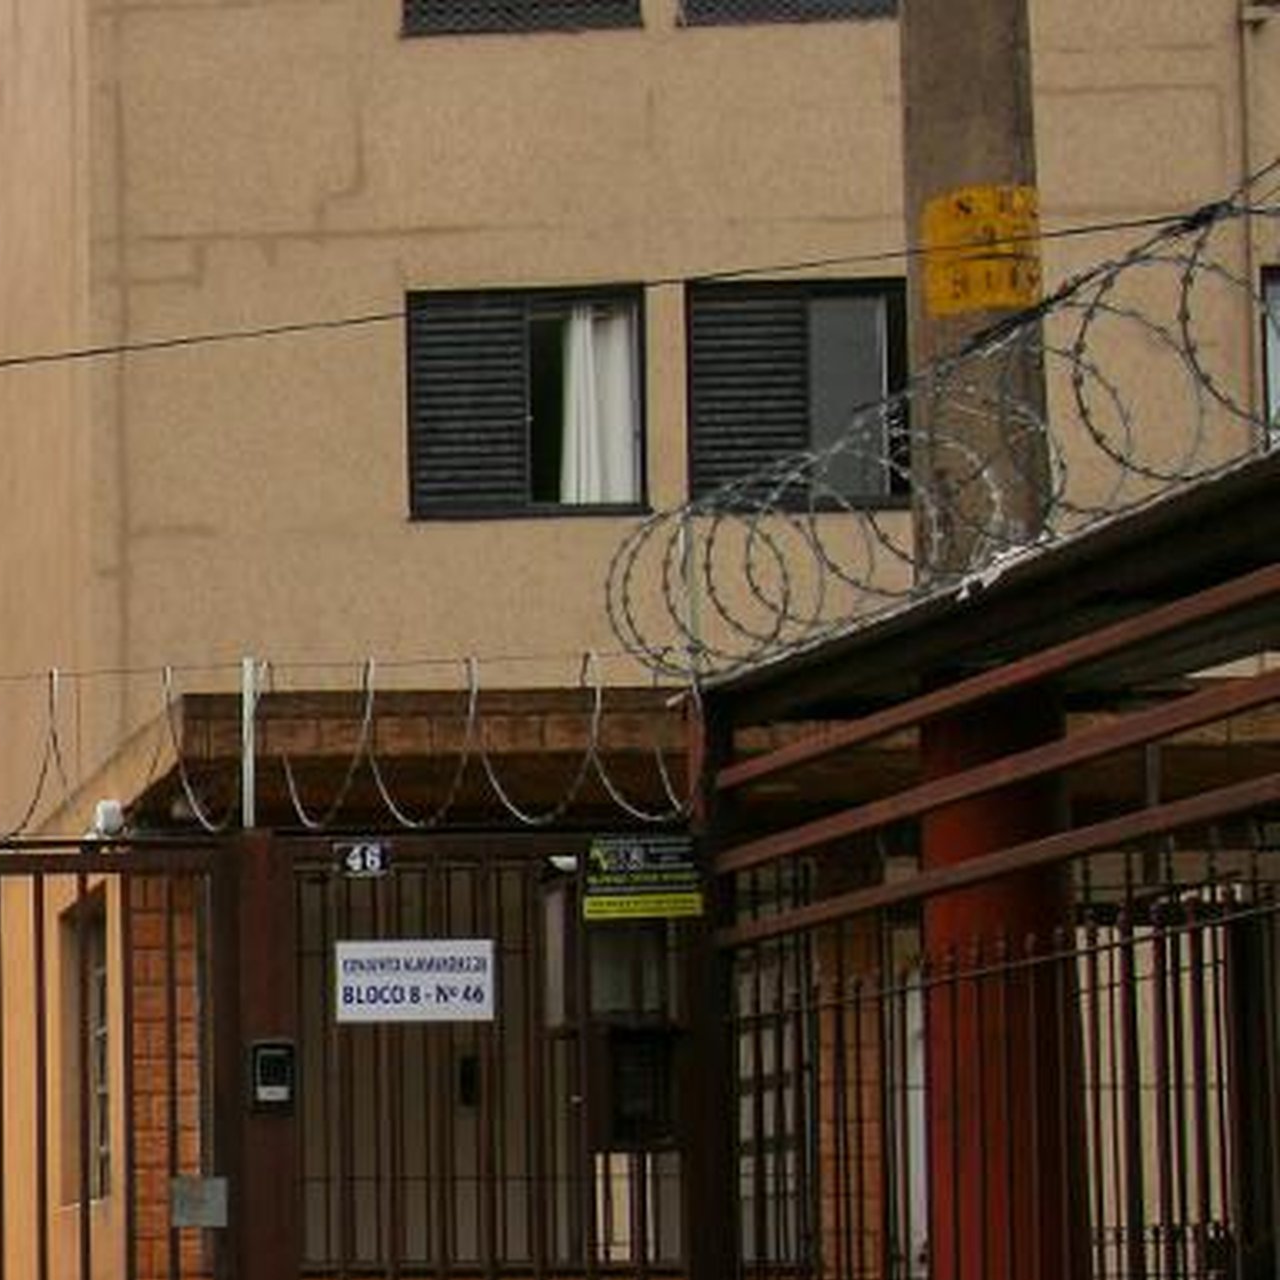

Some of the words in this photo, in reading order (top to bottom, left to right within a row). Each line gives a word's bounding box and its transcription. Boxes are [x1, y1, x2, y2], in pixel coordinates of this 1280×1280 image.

[346, 846, 381, 871] 46
[342, 985, 405, 1004] BLOCO
[463, 984, 485, 1004] 46
